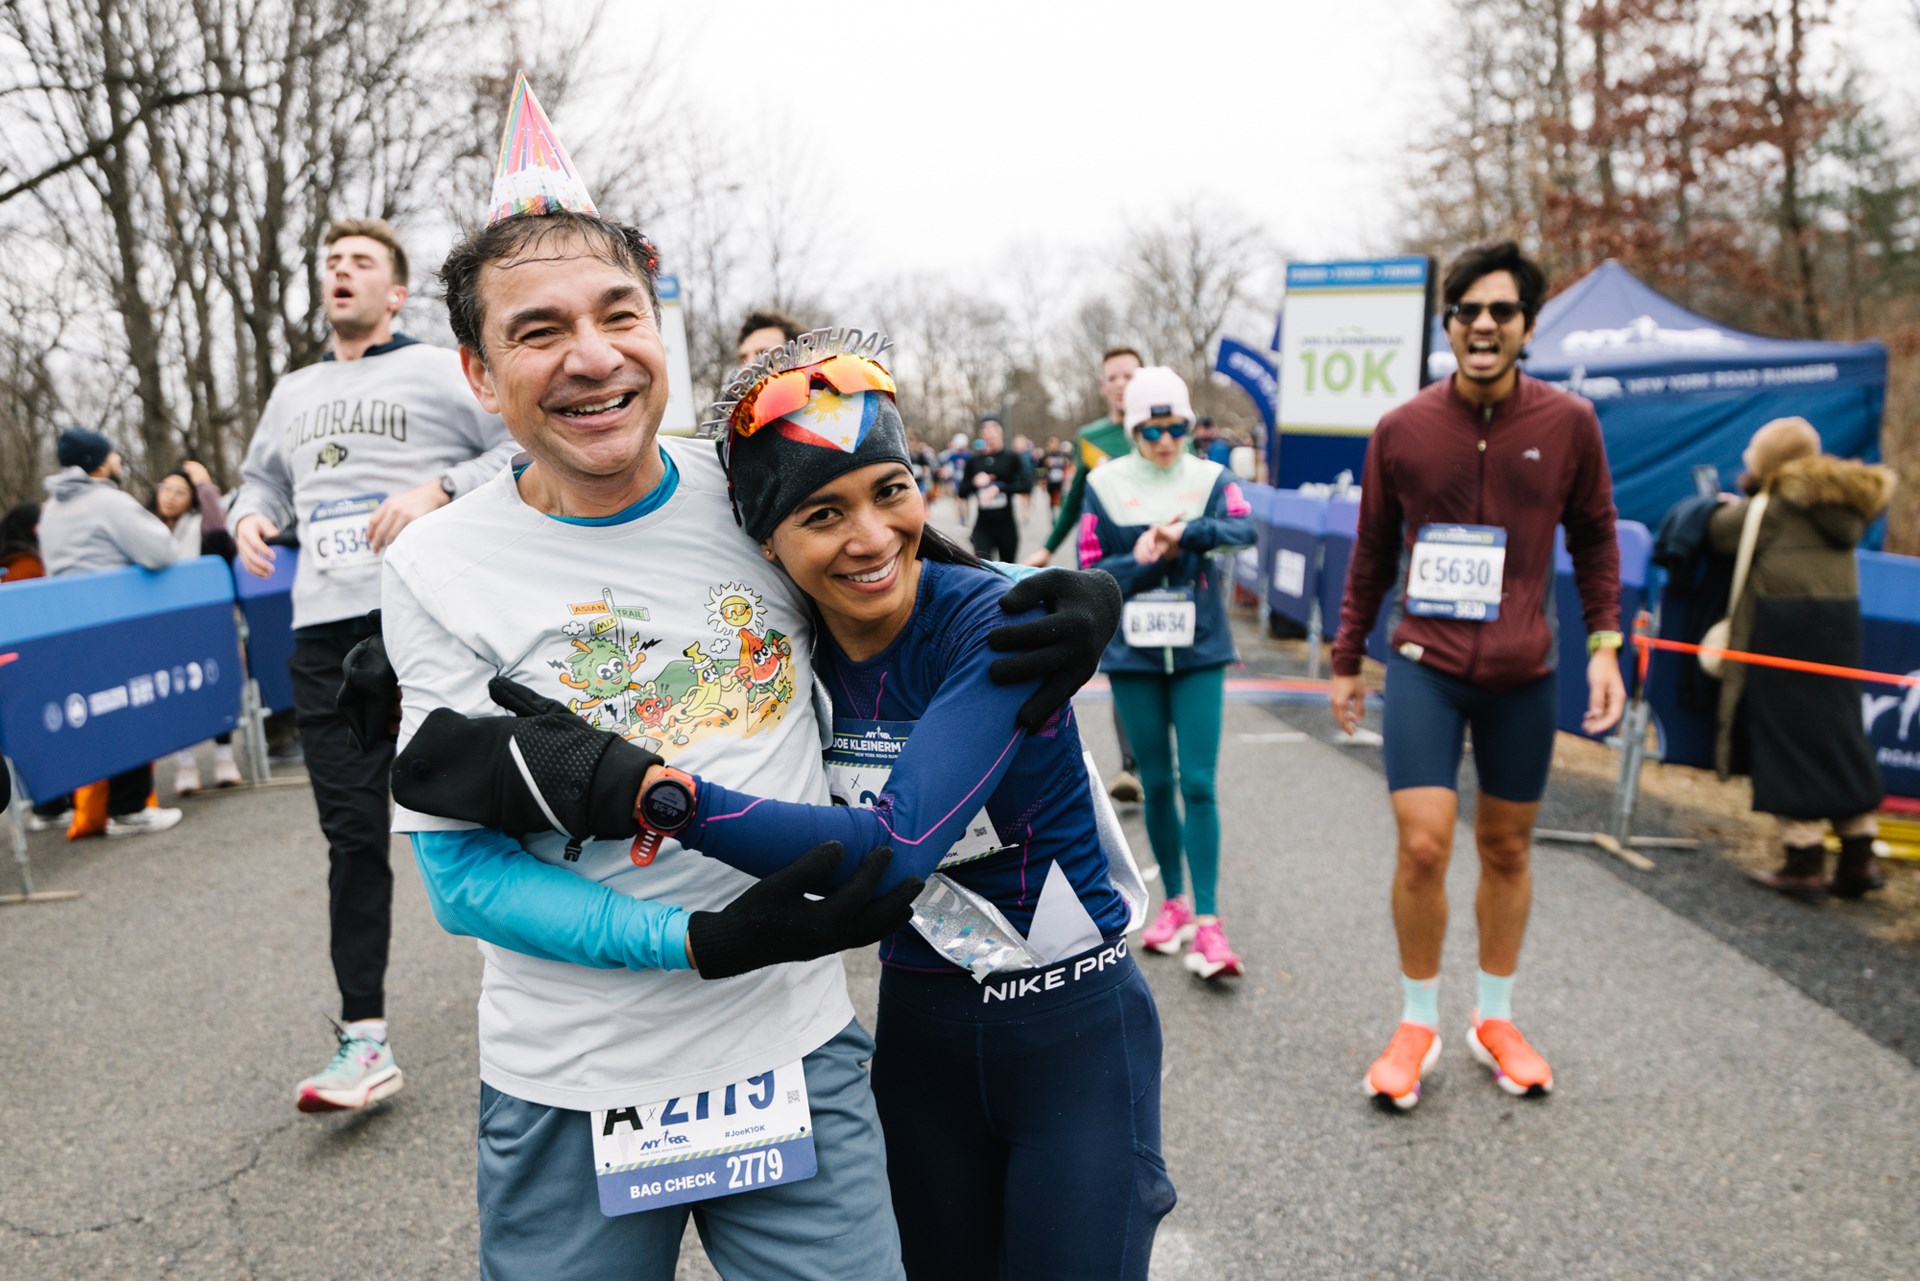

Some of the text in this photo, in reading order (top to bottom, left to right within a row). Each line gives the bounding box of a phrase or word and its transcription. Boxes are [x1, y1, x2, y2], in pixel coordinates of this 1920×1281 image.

[1299, 351, 1398, 394] 10K
[1625, 376, 1667, 393] NEW
[1668, 373, 1711, 390] YORK
[1714, 369, 1759, 387] ROAD
[1761, 363, 1838, 384] RUNNERS
[317, 537, 329, 558] C
[1419, 557, 1491, 586] C 5630
[574, 603, 607, 614] ASIAN
[616, 608, 643, 619] TRAIL
[596, 617, 616, 632] MIX
[833, 738, 849, 749] JOE
[983, 937, 1127, 1004] NIKE PRO
[603, 1106, 643, 1136] A
[640, 1124, 766, 1150] NYRR #JoeK10K
[630, 1148, 784, 1199] BAG CHECK 2779
